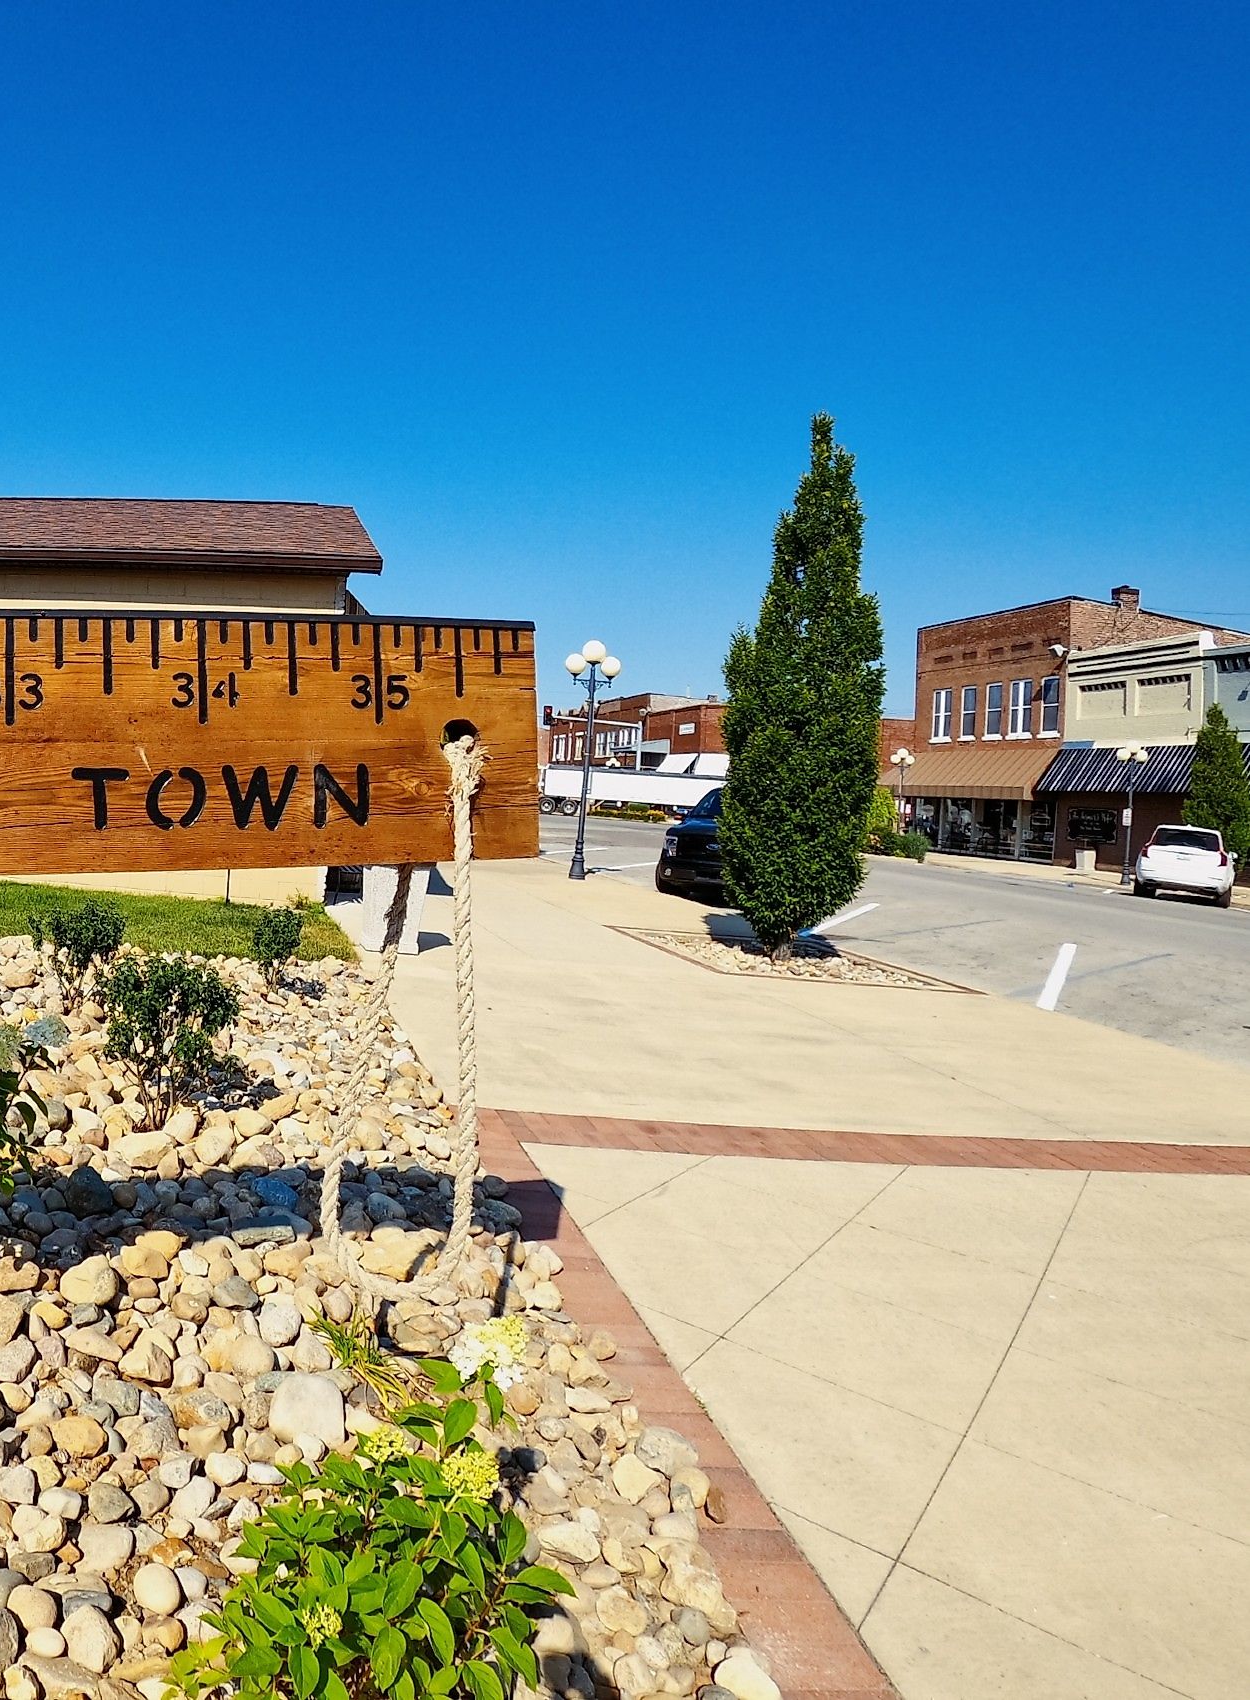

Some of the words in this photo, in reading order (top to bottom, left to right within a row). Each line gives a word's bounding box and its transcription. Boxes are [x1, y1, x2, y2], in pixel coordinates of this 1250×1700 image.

[171, 671, 241, 709] 34
[350, 674, 411, 711] 35
[71, 764, 371, 830] TOWN
